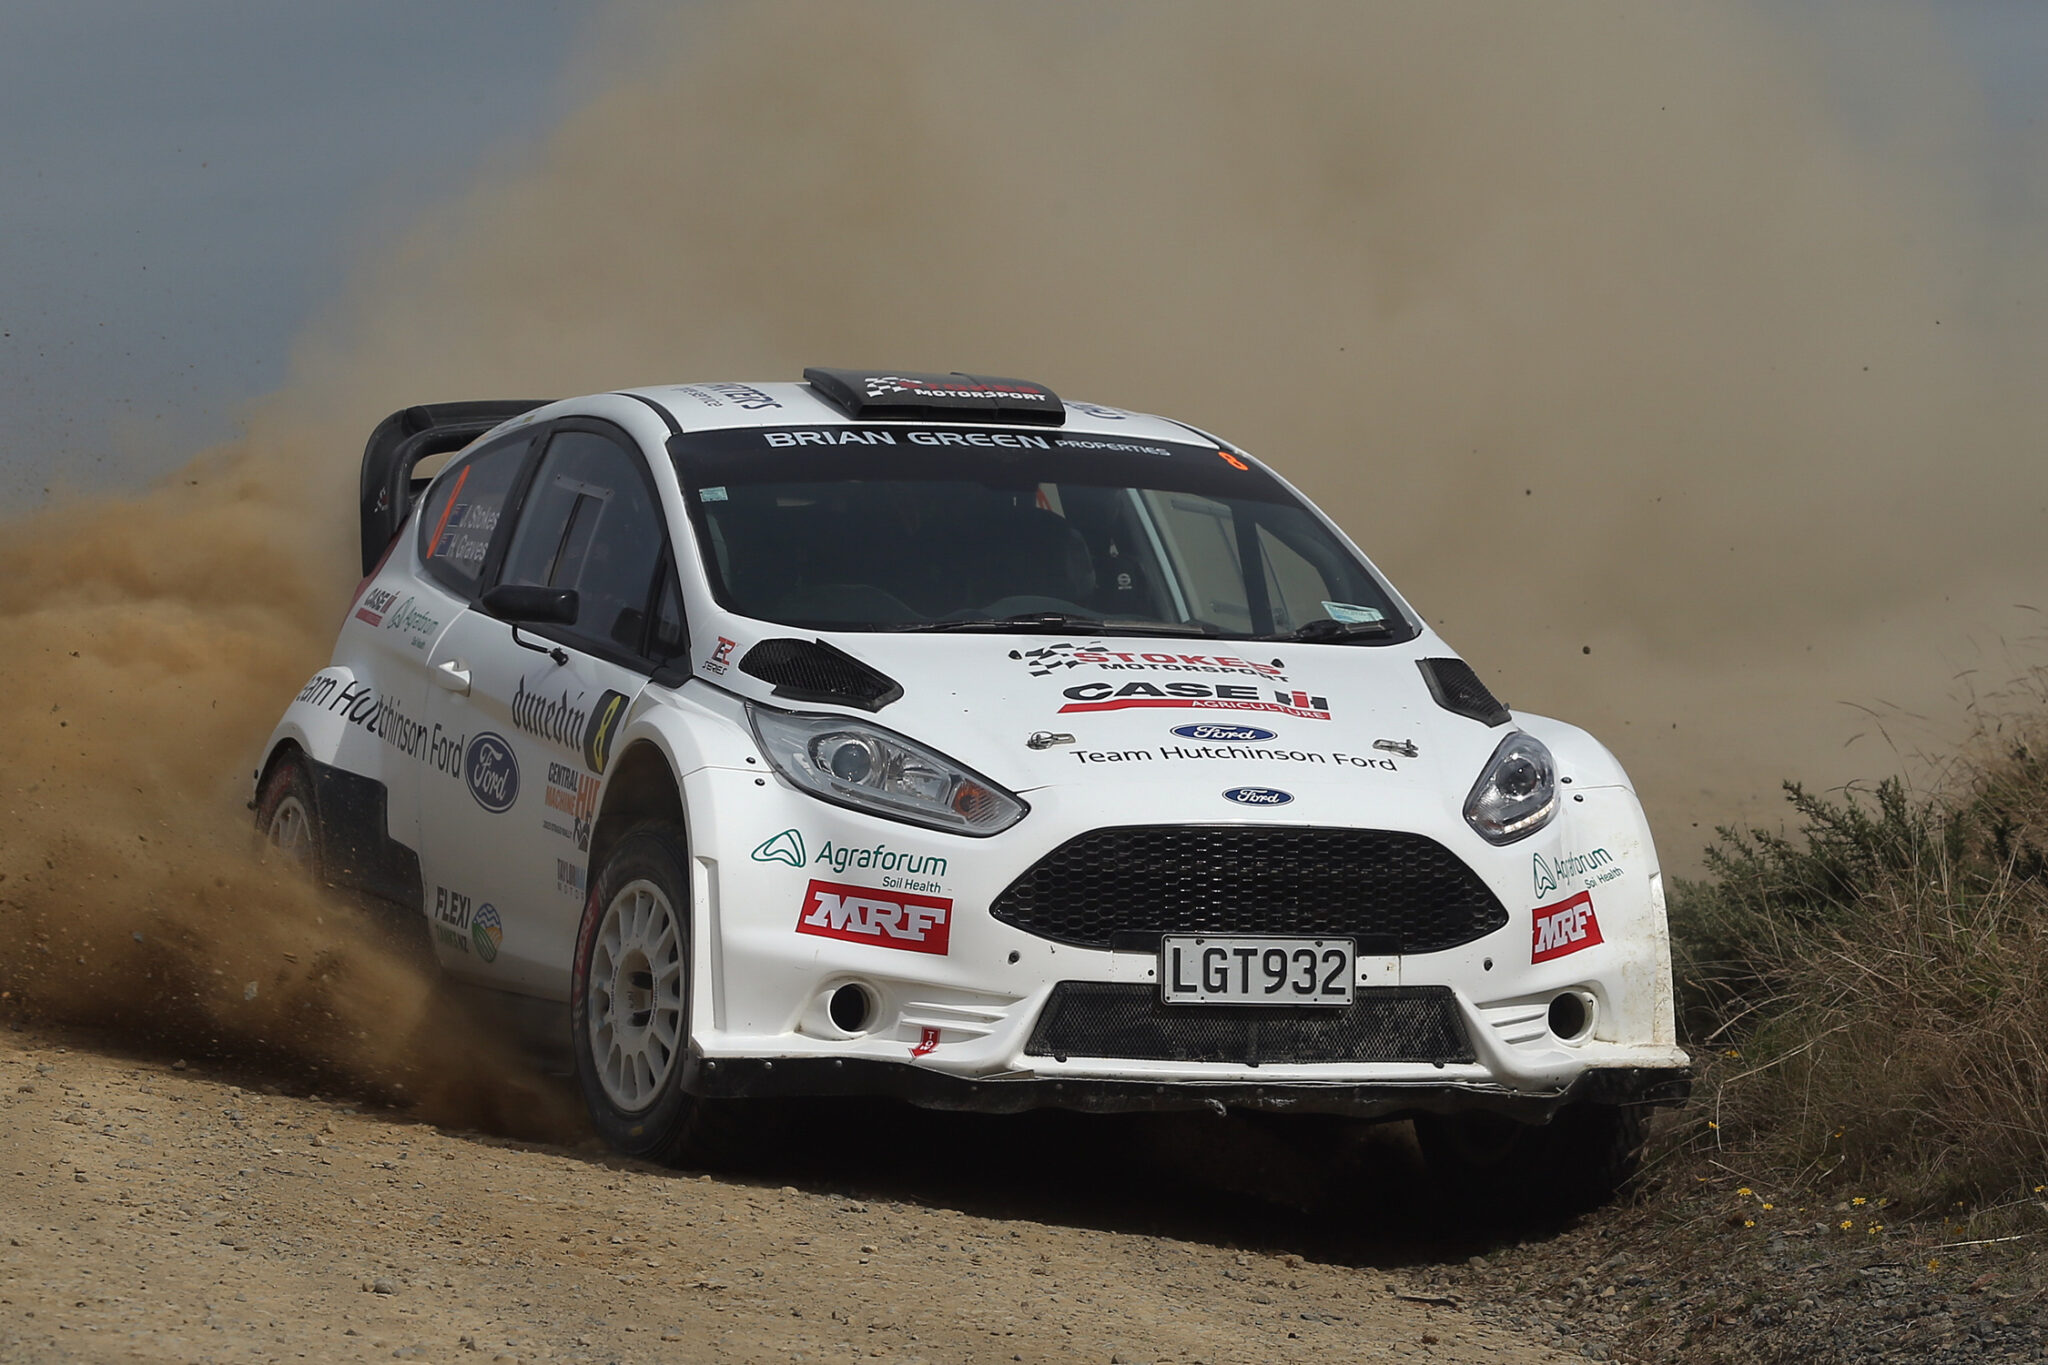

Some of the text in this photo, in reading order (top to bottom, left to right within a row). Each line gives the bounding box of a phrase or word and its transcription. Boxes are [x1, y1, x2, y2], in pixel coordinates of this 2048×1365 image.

[914, 388, 1047, 402] MOTORSPORT
[764, 430, 1171, 456] BRIAN GREEN PROPERTIES
[1074, 651, 1284, 676] STOKES
[1098, 662, 1290, 683] MOTORSPORT
[1062, 682, 1260, 700] CASE
[512, 674, 585, 753] dunedin
[1191, 700, 1327, 719] AGRICULTURE
[329, 680, 428, 761] Hutchinson
[429, 723, 465, 779] Ford
[1193, 724, 1257, 741] Ford
[474, 742, 507, 800] Ford
[1069, 746, 1399, 772] Team Hutchinson Ford
[548, 761, 578, 793] CENTRAL
[1236, 788, 1280, 804] Ford
[815, 840, 947, 876] Agraforum
[1553, 847, 1613, 886] Agraforum
[882, 876, 941, 894] Soil Health
[1599, 867, 1625, 884] Health
[435, 886, 471, 930] FLEXI
[803, 891, 946, 941] MRF
[1534, 901, 1593, 954] MRF
[1173, 947, 1347, 995] LGT932
